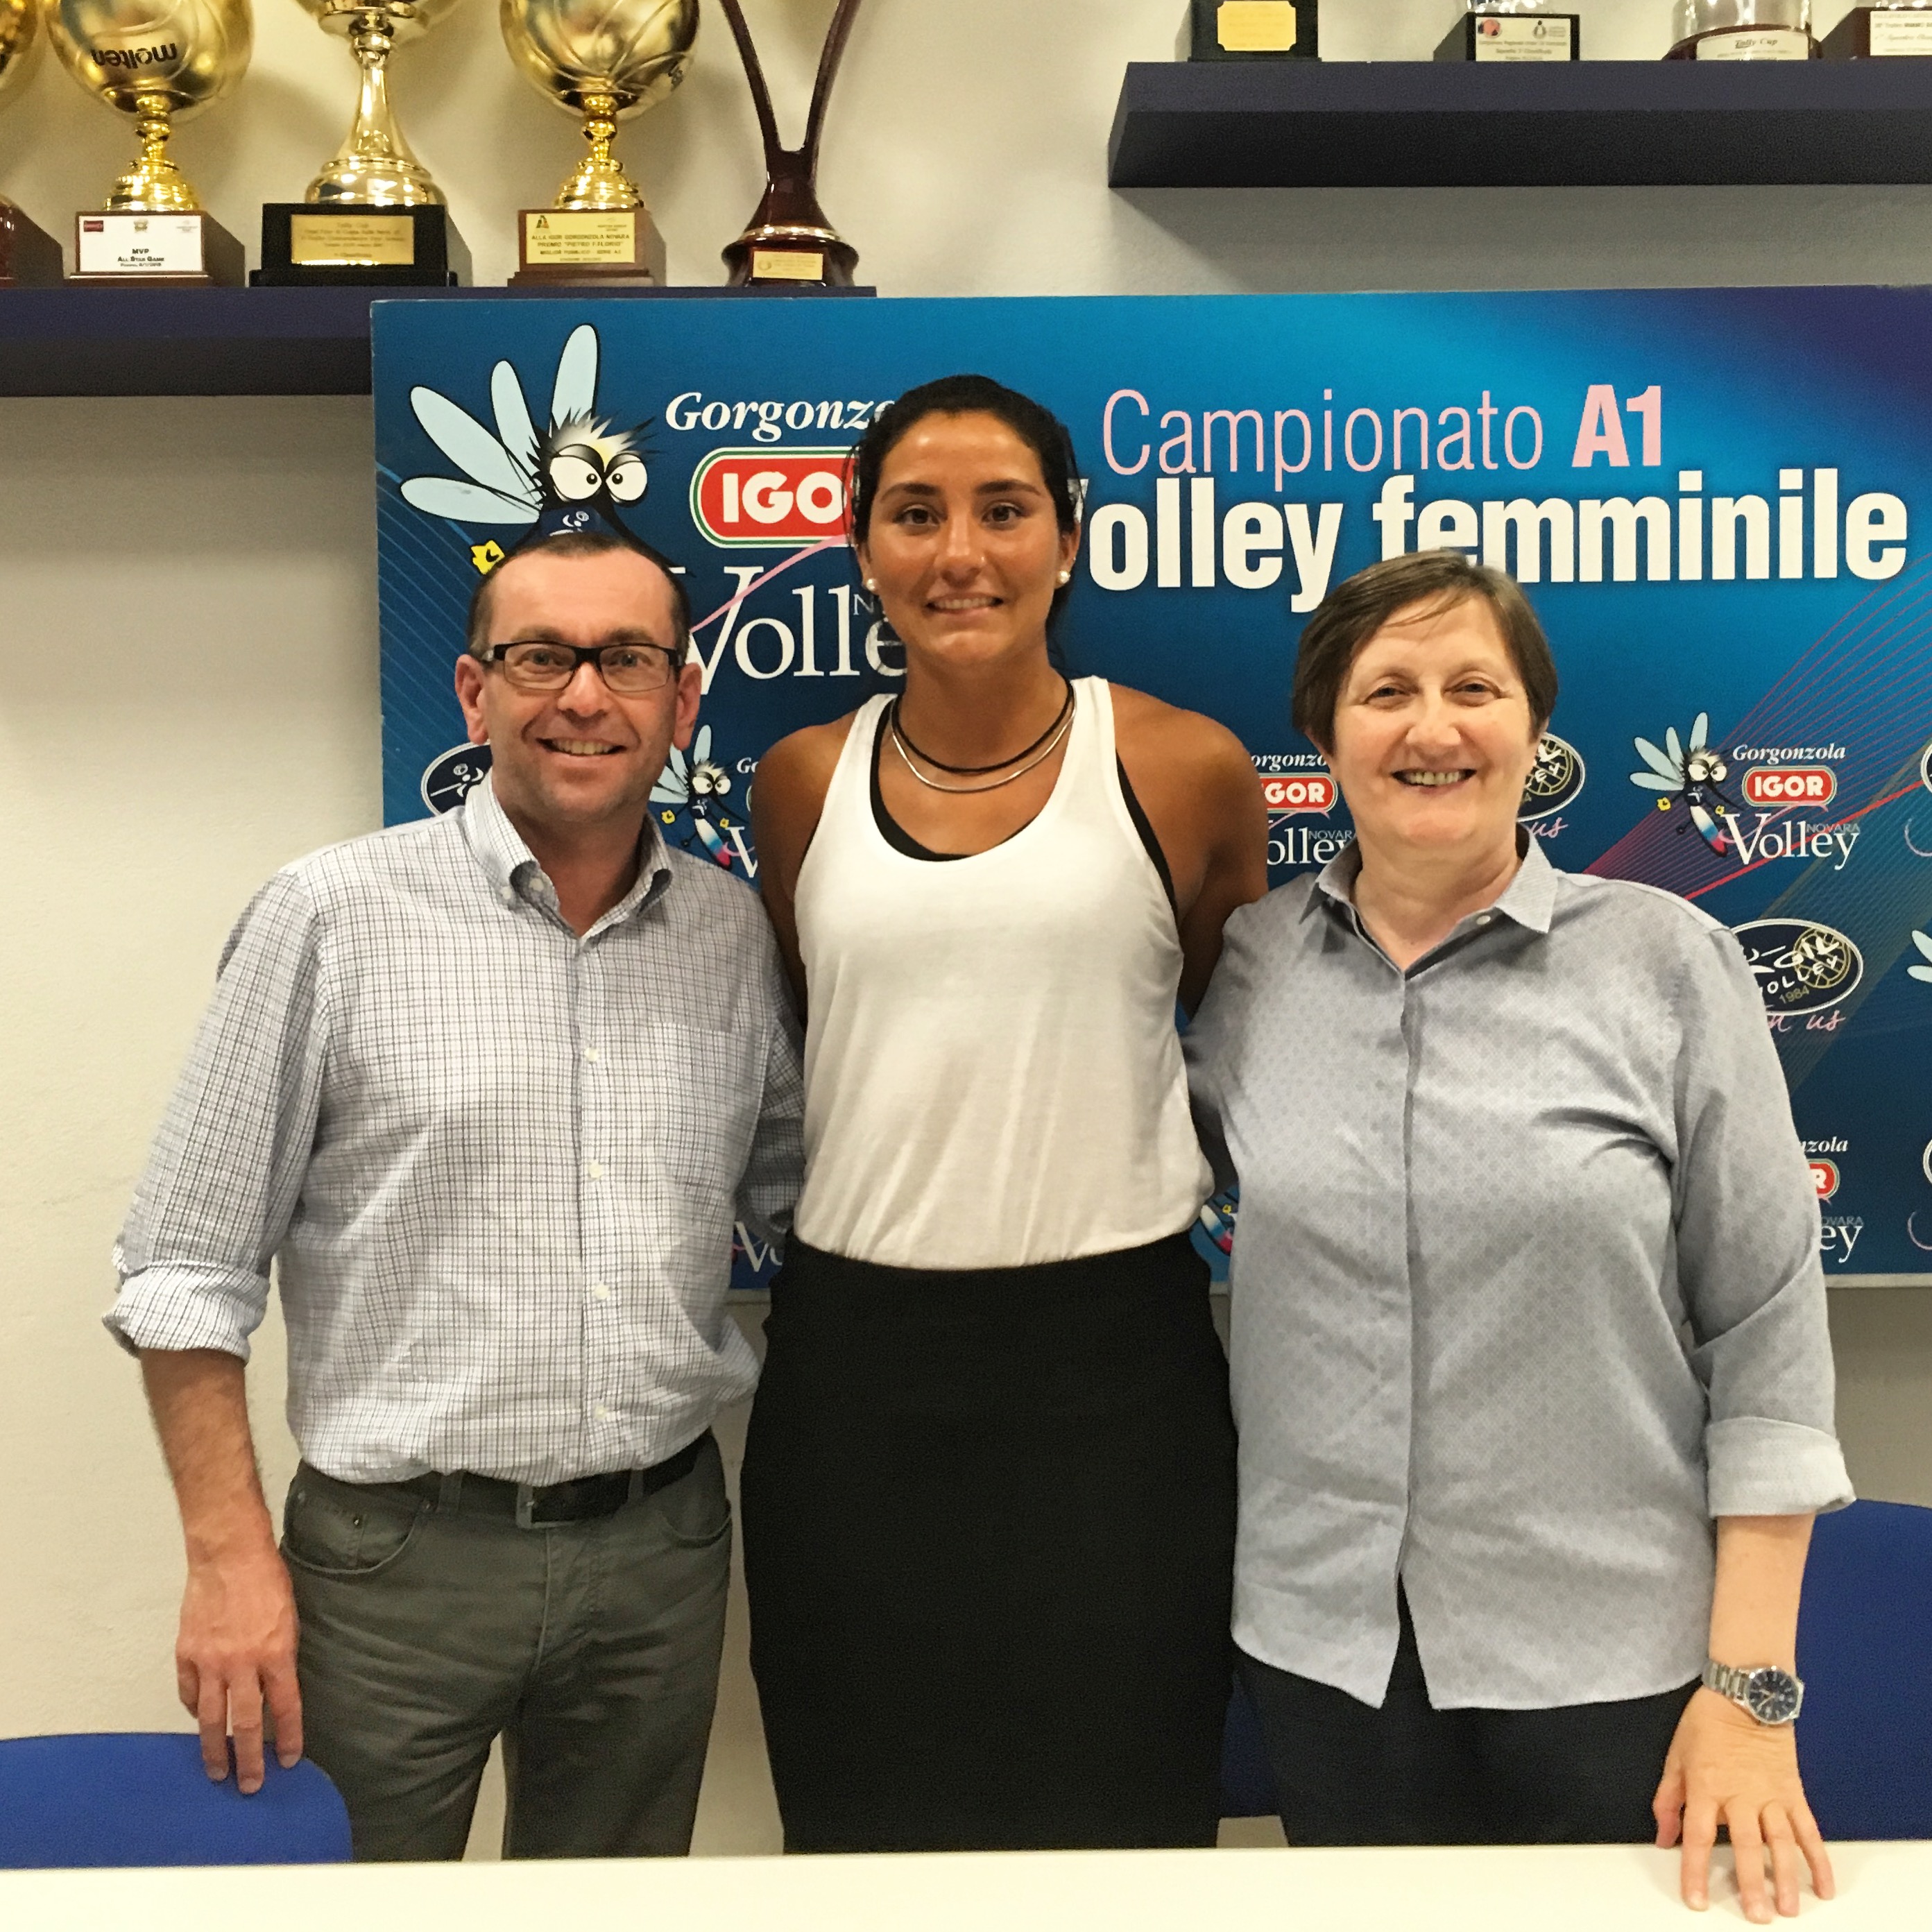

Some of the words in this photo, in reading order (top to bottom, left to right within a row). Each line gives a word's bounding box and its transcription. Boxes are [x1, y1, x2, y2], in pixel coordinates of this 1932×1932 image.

[90, 43, 177, 69] molten
[1103, 388, 1542, 492] Campionato
[1572, 384, 1661, 468] A1
[723, 472, 861, 524] IGO
[1074, 477, 1343, 613] olley
[1373, 468, 1907, 583] femminile
[1733, 742, 1846, 764] Gorgonzola
[1262, 782, 1325, 804] GOR
[1754, 776, 1824, 797] IGOR
[1308, 830, 1356, 840] NOVAR
[1806, 823, 1861, 832] NOVARA
[1720, 812, 1861, 871] Volley
[1760, 955, 1838, 994] OLLEY
[1779, 985, 1809, 1004] 1984
[1806, 1010, 1846, 1031] us
